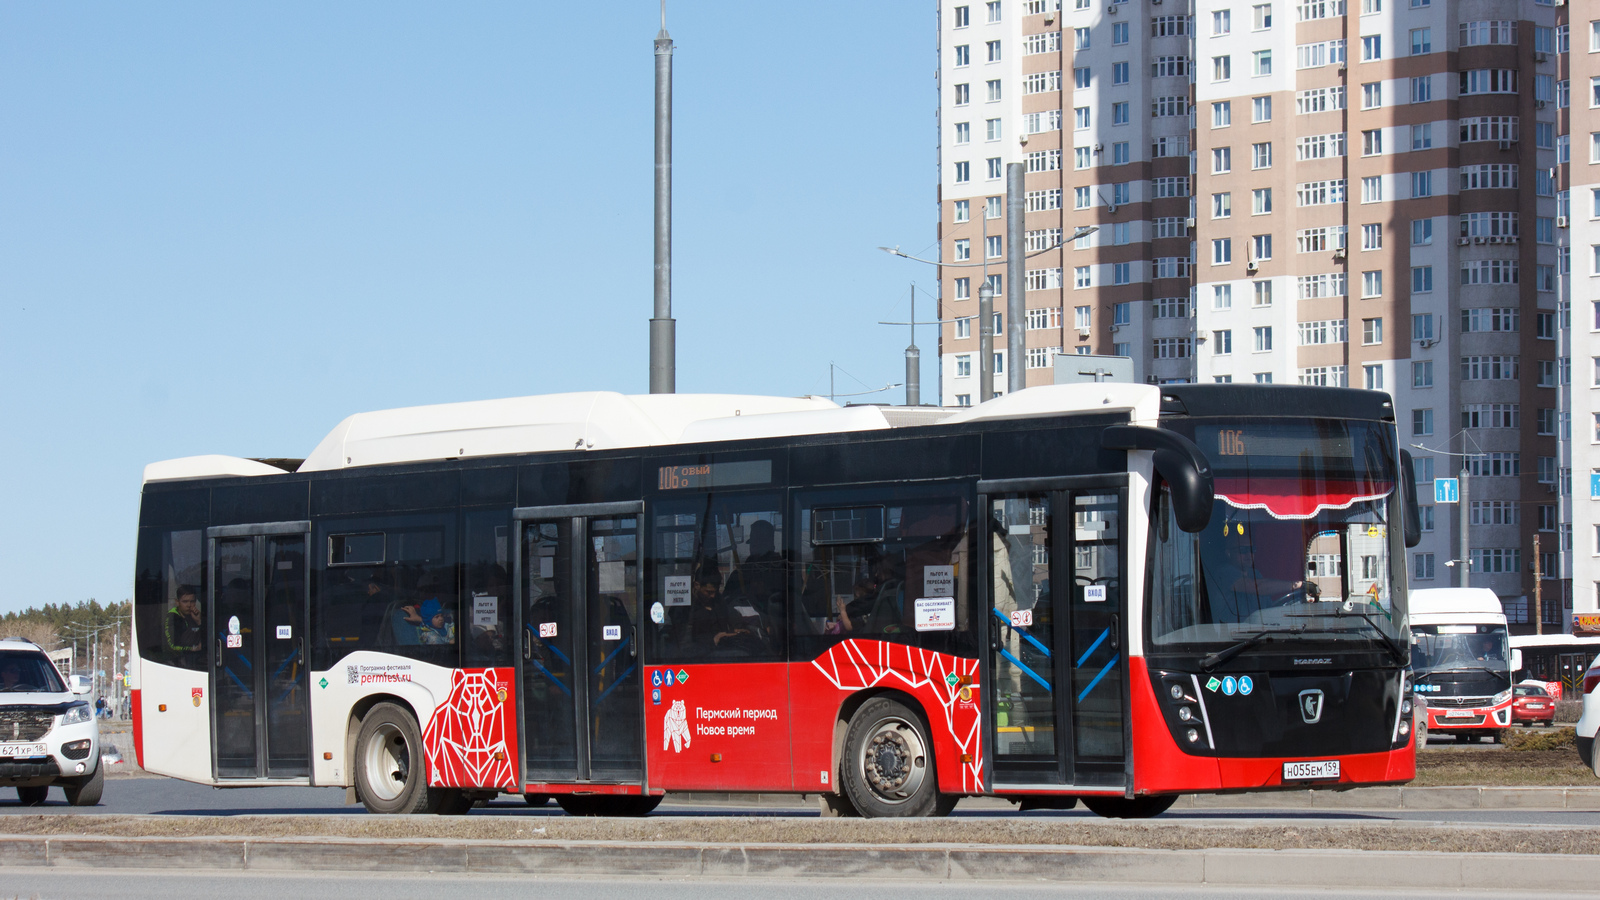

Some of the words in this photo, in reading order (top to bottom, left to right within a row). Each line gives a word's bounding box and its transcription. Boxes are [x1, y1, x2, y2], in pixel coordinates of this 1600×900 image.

[1220, 430, 1244, 455] 106
[659, 466, 679, 490] 106
[682, 465, 710, 476] овый
[1088, 589, 1102, 597] ВХОД
[361, 672, 411, 686] permfest.ru
[696, 707, 741, 722] Пермский
[743, 709, 778, 721] период
[696, 723, 726, 736] Новое
[727, 726, 756, 738] время
[1287, 764, 1322, 777] Н055ЕМ
[1324, 762, 1337, 771] 159
